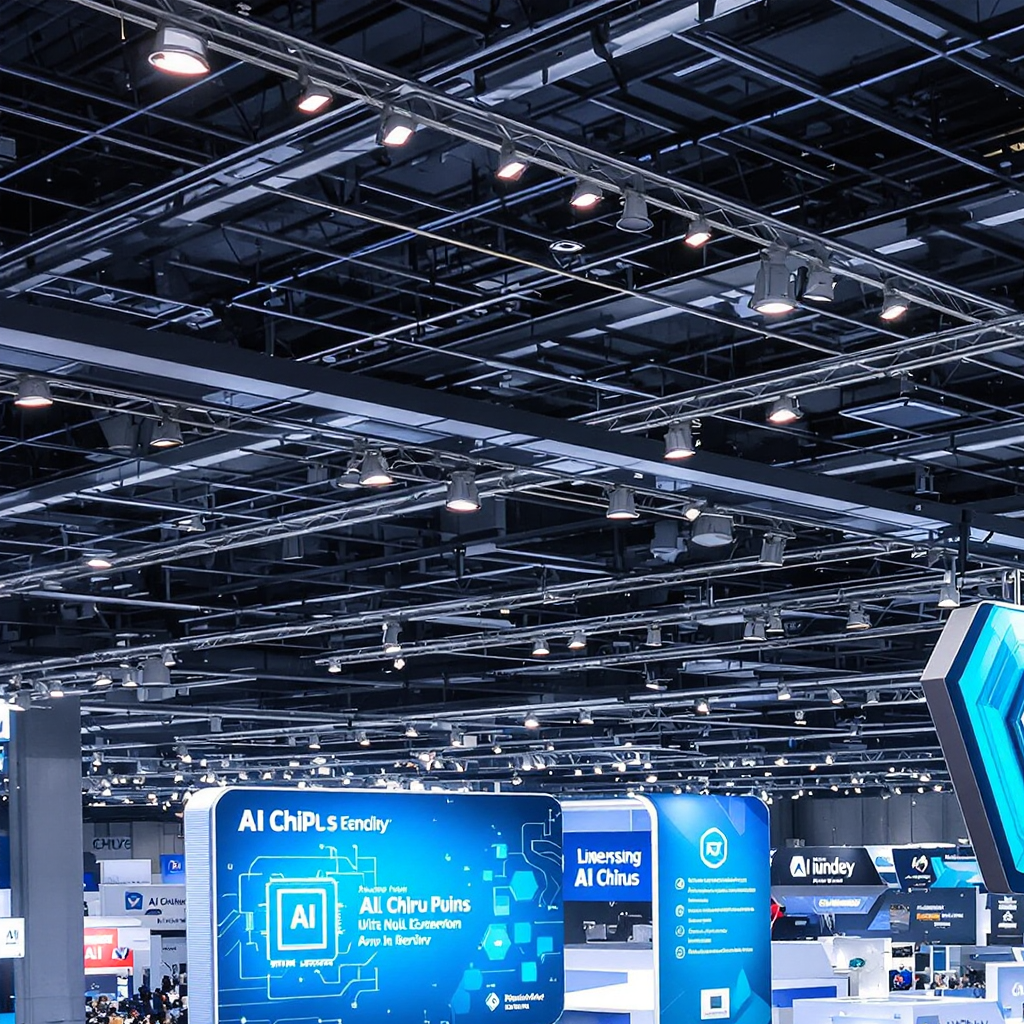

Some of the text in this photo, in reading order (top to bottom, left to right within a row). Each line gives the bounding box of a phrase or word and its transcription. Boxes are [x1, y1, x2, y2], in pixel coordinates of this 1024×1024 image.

[238, 809, 264, 832] AI
[574, 868, 594, 888] AI
[290, 903, 316, 930] AI
